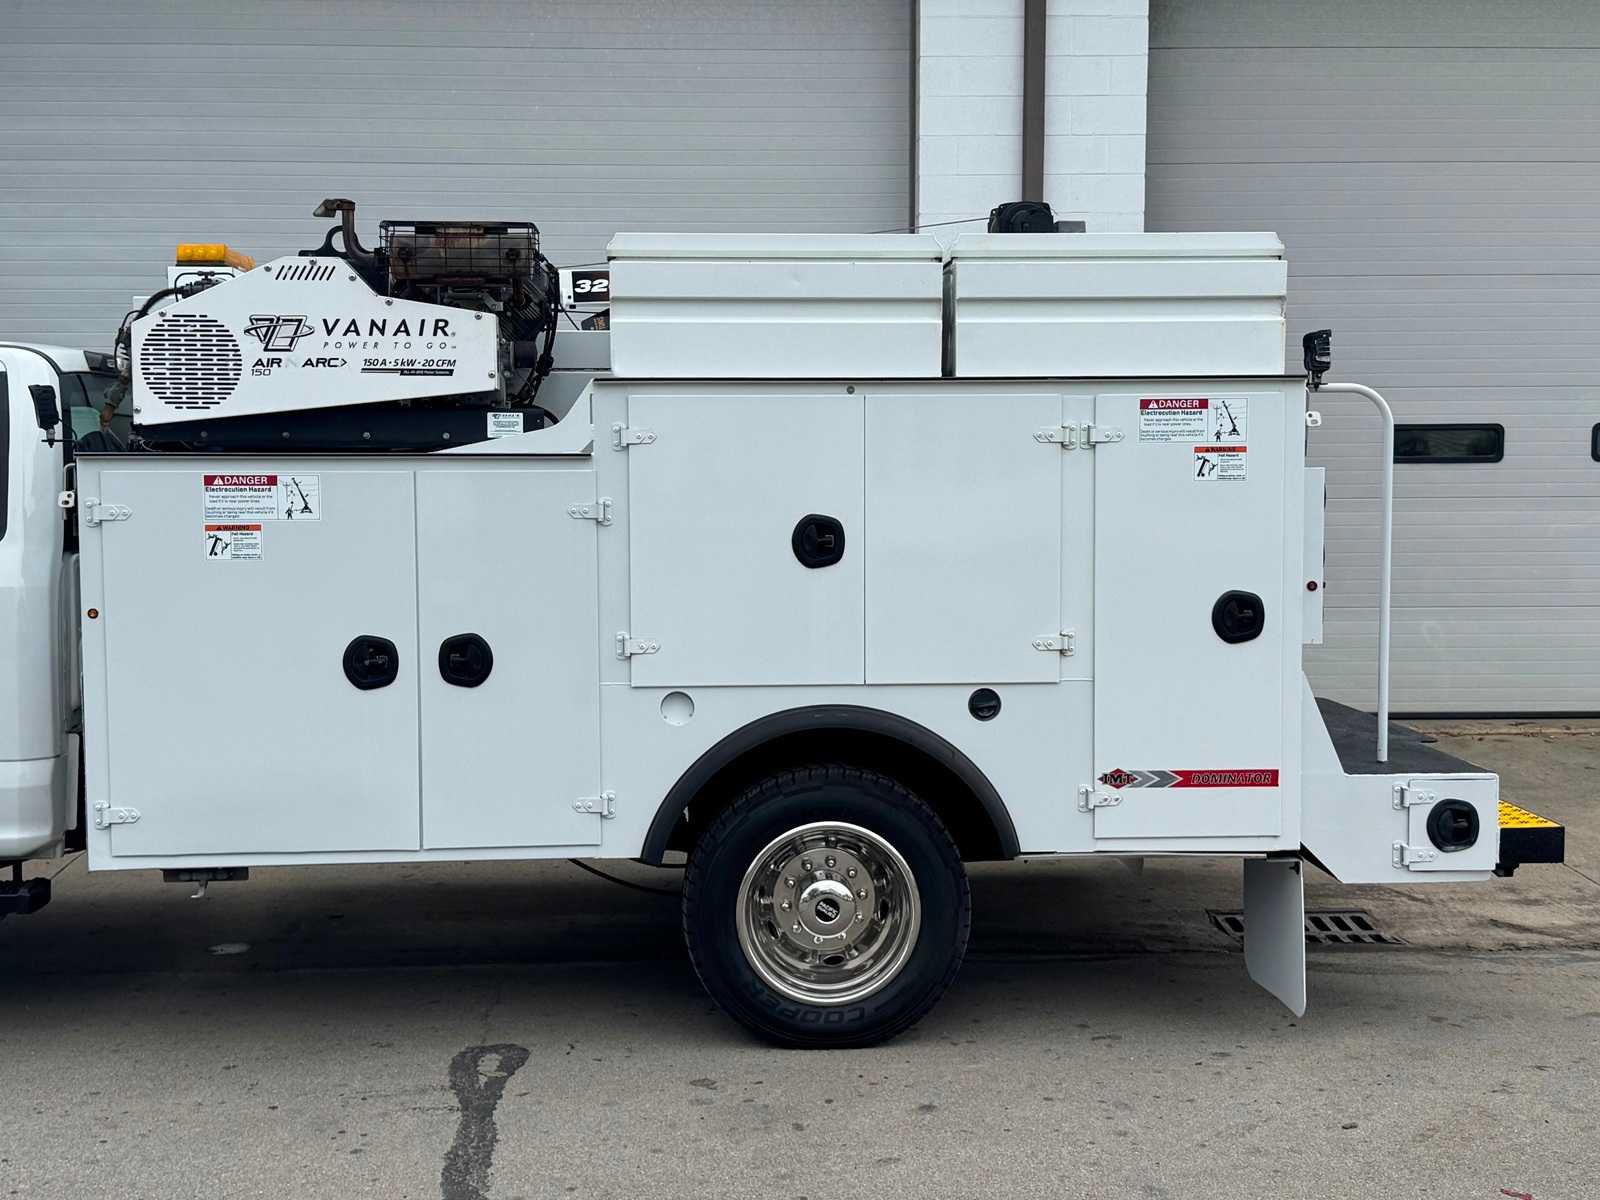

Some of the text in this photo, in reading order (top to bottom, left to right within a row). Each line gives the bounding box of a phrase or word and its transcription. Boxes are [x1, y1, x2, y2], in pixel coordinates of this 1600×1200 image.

[574, 279, 609, 293] 32
[322, 318, 450, 337] VANAIR
[323, 341, 447, 350] POWER TO GO
[252, 357, 283, 368] AIR
[363, 358, 456, 368] 150 A 5 kW 20 CFM
[250, 368, 272, 377] 150
[1158, 400, 1200, 408] DANGER
[224, 476, 268, 485] DANGER
[1190, 772, 1272, 785] DOMINATOR
